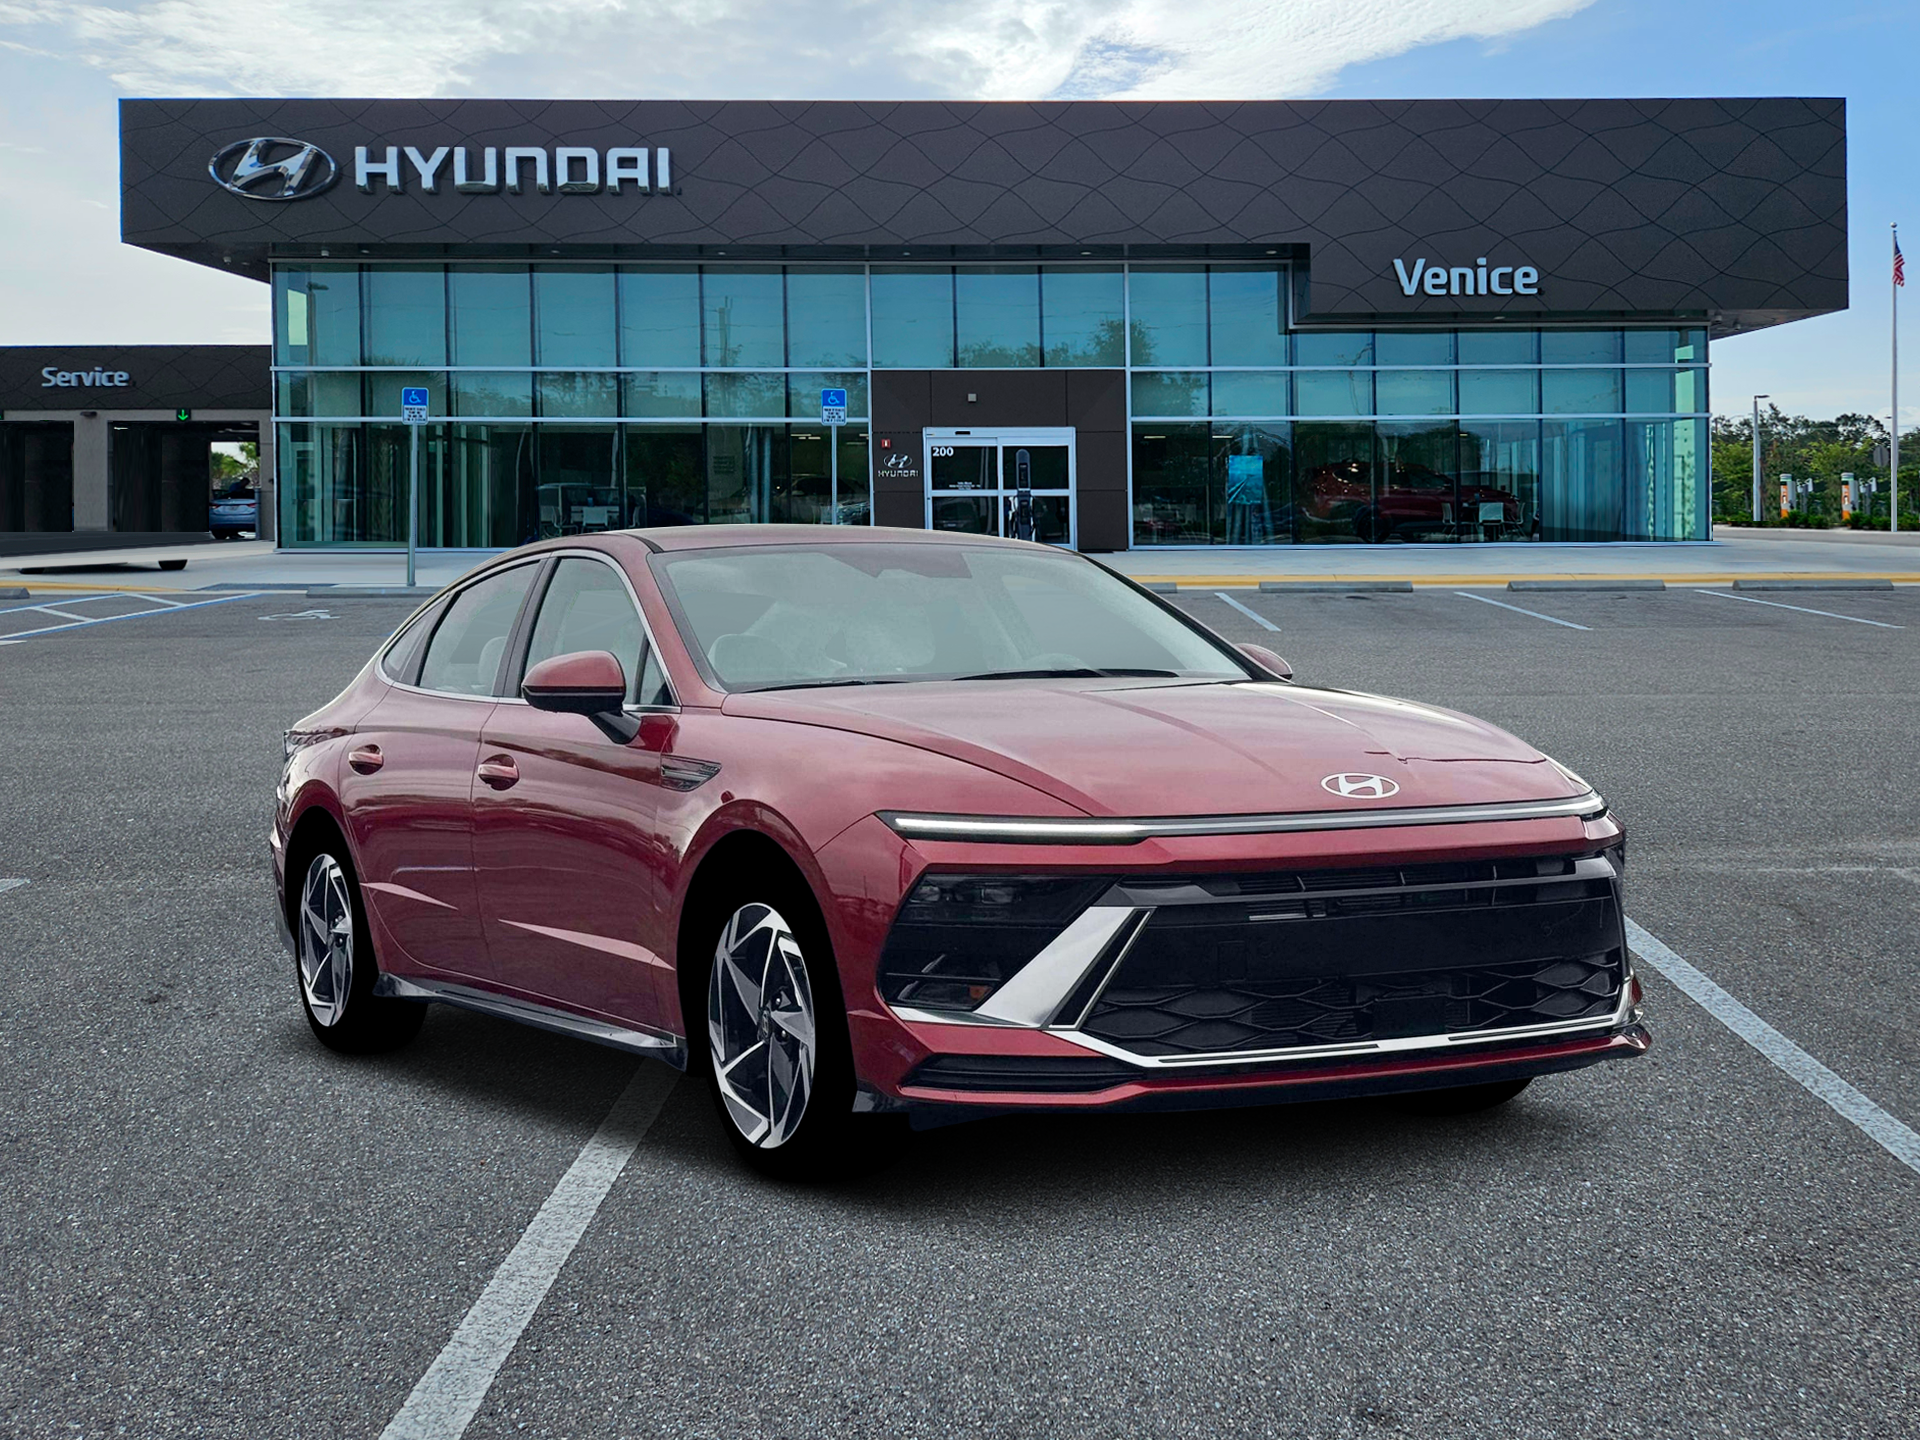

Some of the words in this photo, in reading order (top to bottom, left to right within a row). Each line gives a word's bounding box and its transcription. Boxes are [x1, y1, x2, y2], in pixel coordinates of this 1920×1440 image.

[354, 146, 671, 194] HYUNDAI
[1393, 257, 1539, 296] Venice
[41, 366, 130, 388] Service
[932, 446, 954, 457] 200
